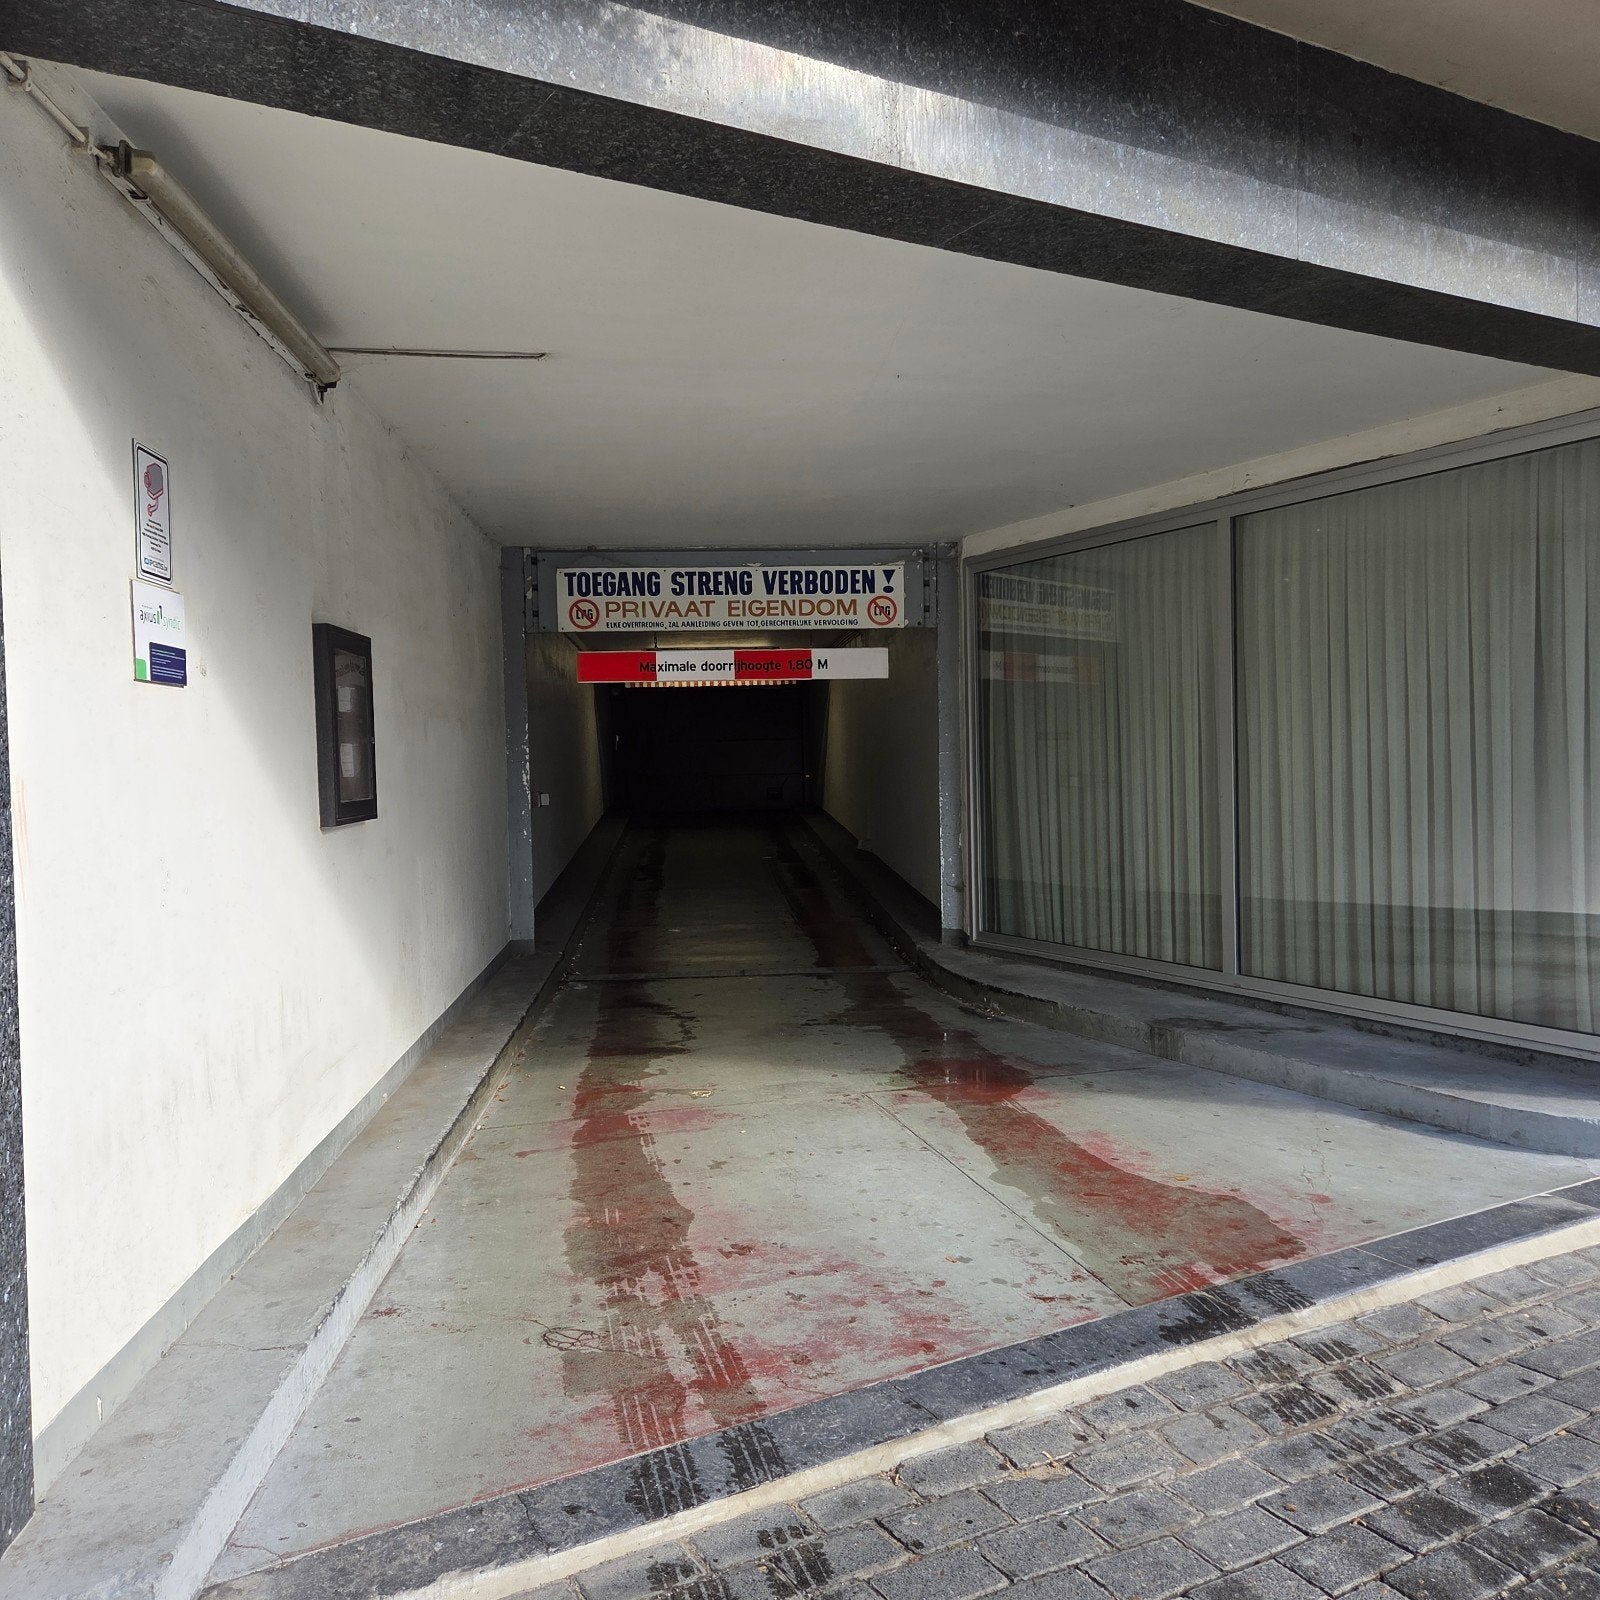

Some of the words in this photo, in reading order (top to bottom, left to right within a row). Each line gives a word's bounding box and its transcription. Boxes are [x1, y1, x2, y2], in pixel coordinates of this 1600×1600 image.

[564, 571, 661, 597] TOEGANG
[671, 571, 753, 596] STRENG
[605, 600, 716, 618] PRIVAAT
[728, 599, 858, 617] EIGENDOM
[606, 621, 622, 629] ELKE
[681, 620, 721, 628] AANLEIDING
[814, 618, 859, 626] VERVOLGING
[639, 660, 697, 672] Maximale
[701, 659, 782, 675] doorrijhoogte
[788, 659, 813, 672] 1,80
[818, 659, 828, 670] M
